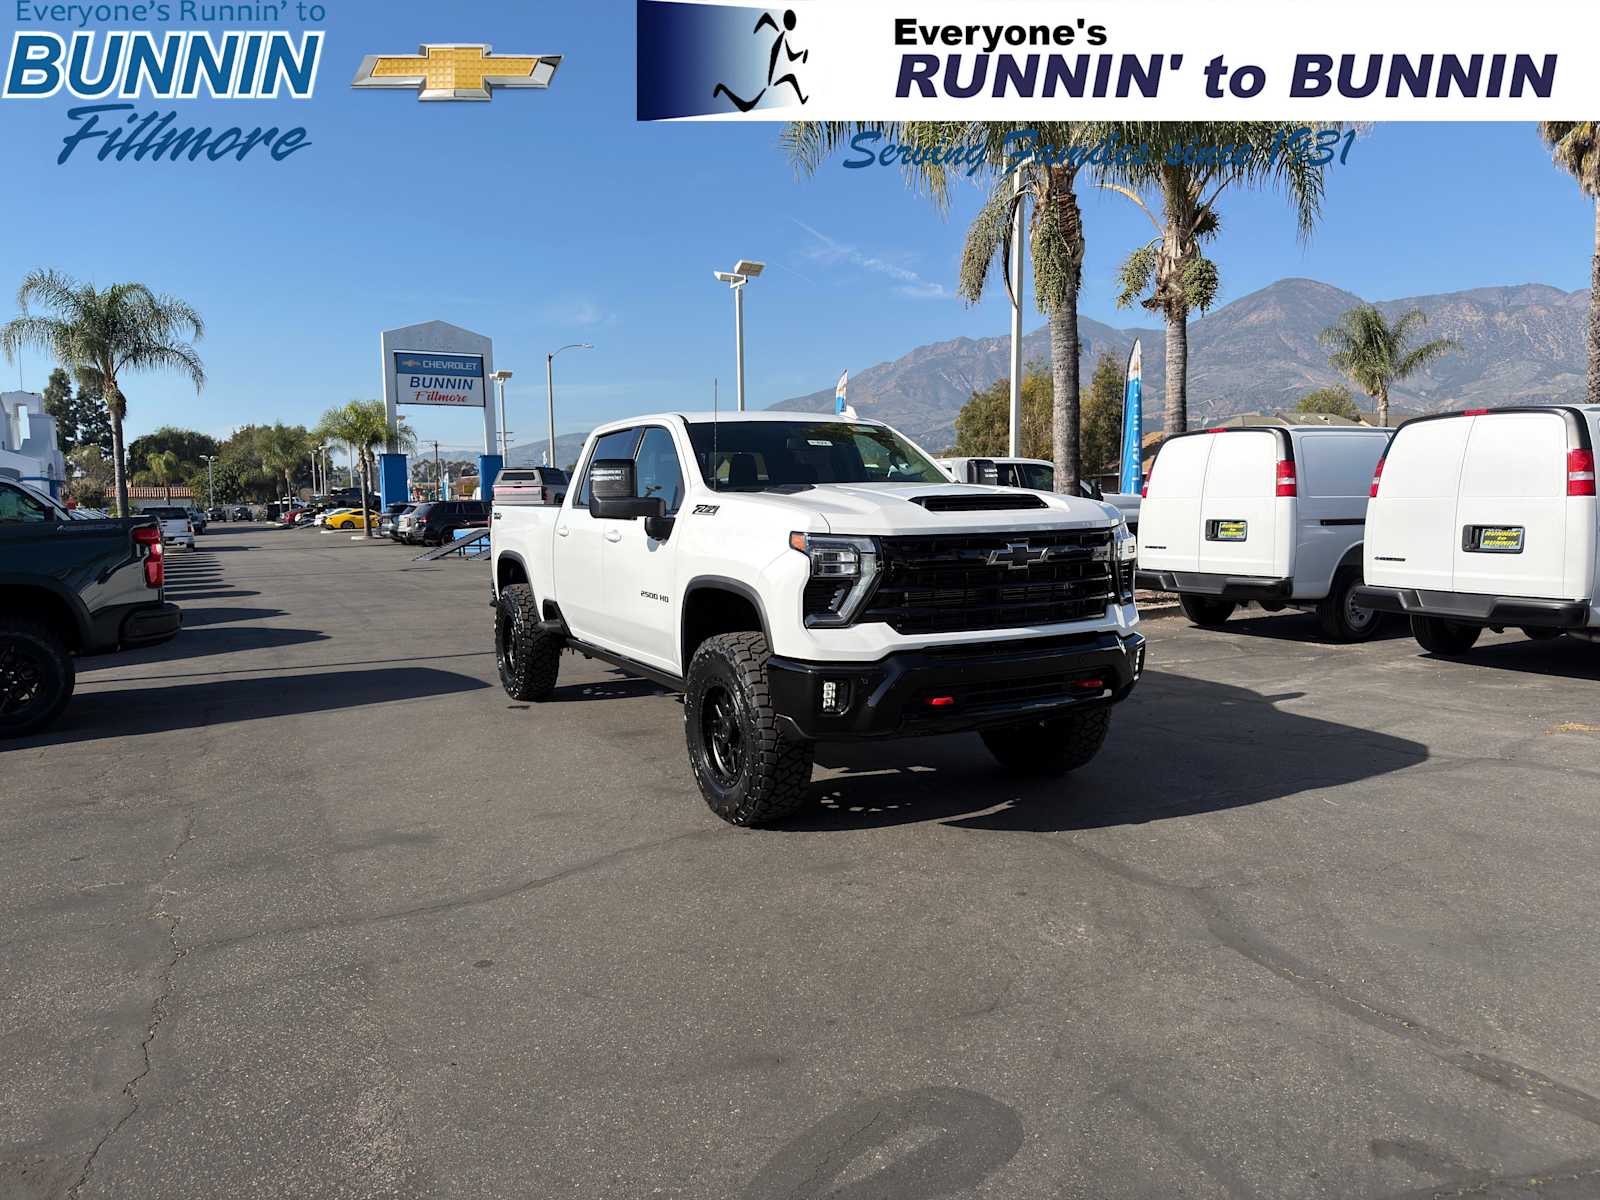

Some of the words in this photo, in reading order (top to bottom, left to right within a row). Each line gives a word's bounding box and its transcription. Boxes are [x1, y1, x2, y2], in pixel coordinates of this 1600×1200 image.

[422, 359, 478, 371] CHEVROLET
[409, 376, 474, 390] BUNNIN
[412, 390, 468, 403] Fillmore
[640, 590, 658, 600] 2500
[660, 594, 669, 603] HD
